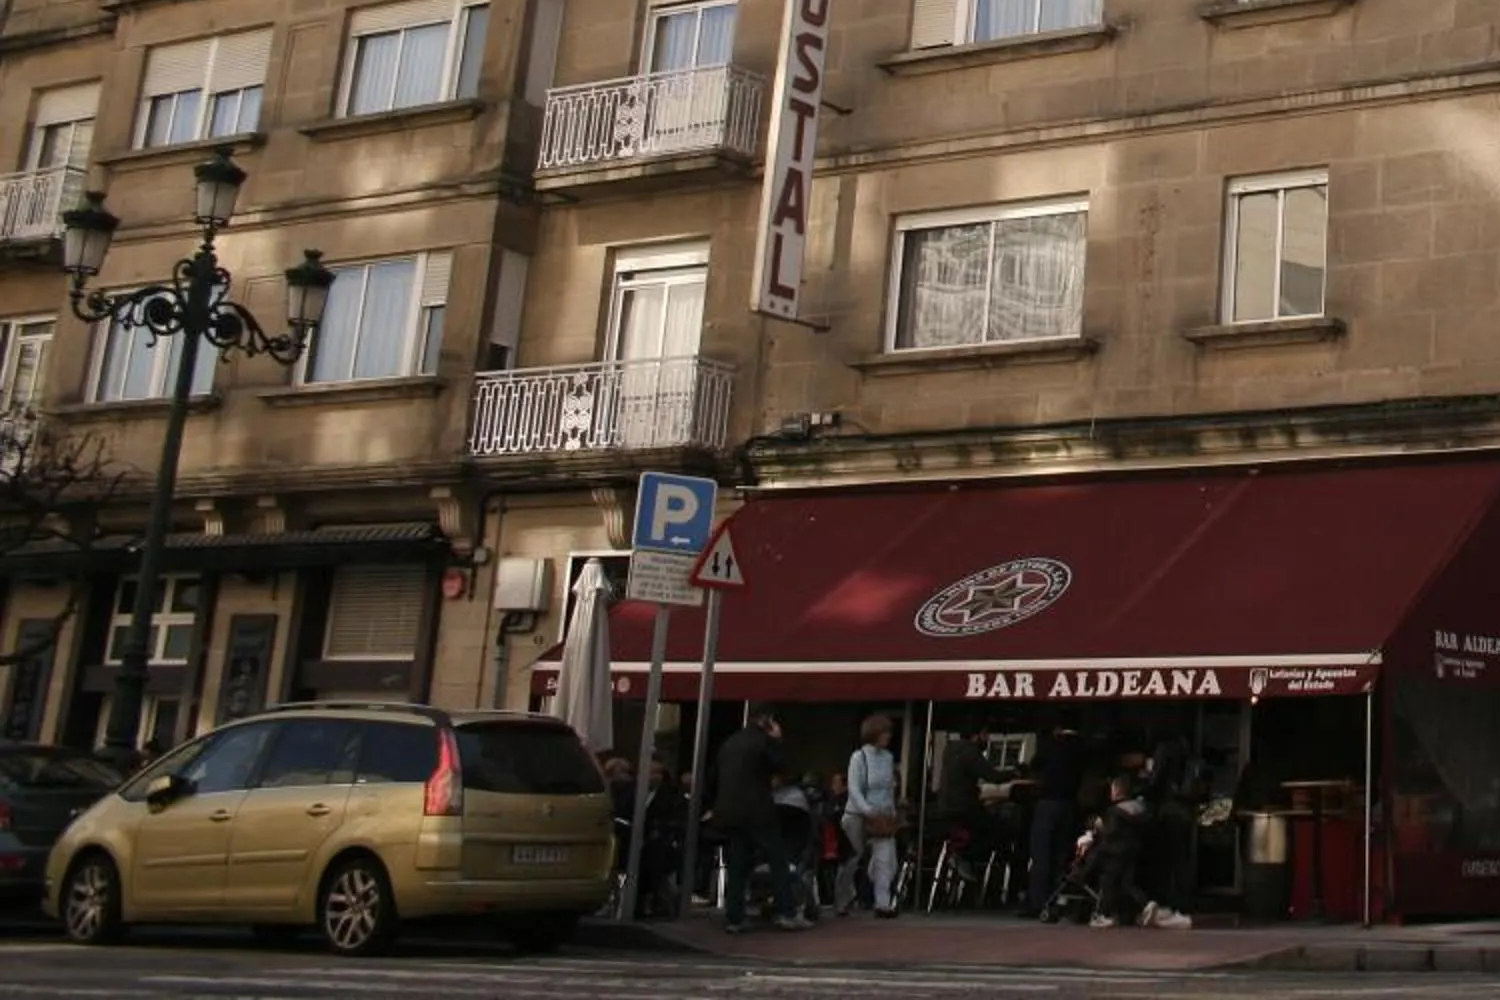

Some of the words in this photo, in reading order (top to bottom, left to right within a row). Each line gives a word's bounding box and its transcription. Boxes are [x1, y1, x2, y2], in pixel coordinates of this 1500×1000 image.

[651, 483, 698, 541] P
[1434, 629, 1459, 652] BAR
[966, 672, 1035, 697] BAR
[1048, 669, 1222, 697] ALDEANA
[1287, 679, 1303, 690] del
[1303, 679, 1335, 691] Estado
[1307, 671, 1314, 681] y
[1314, 667, 1357, 681] Apuestas
